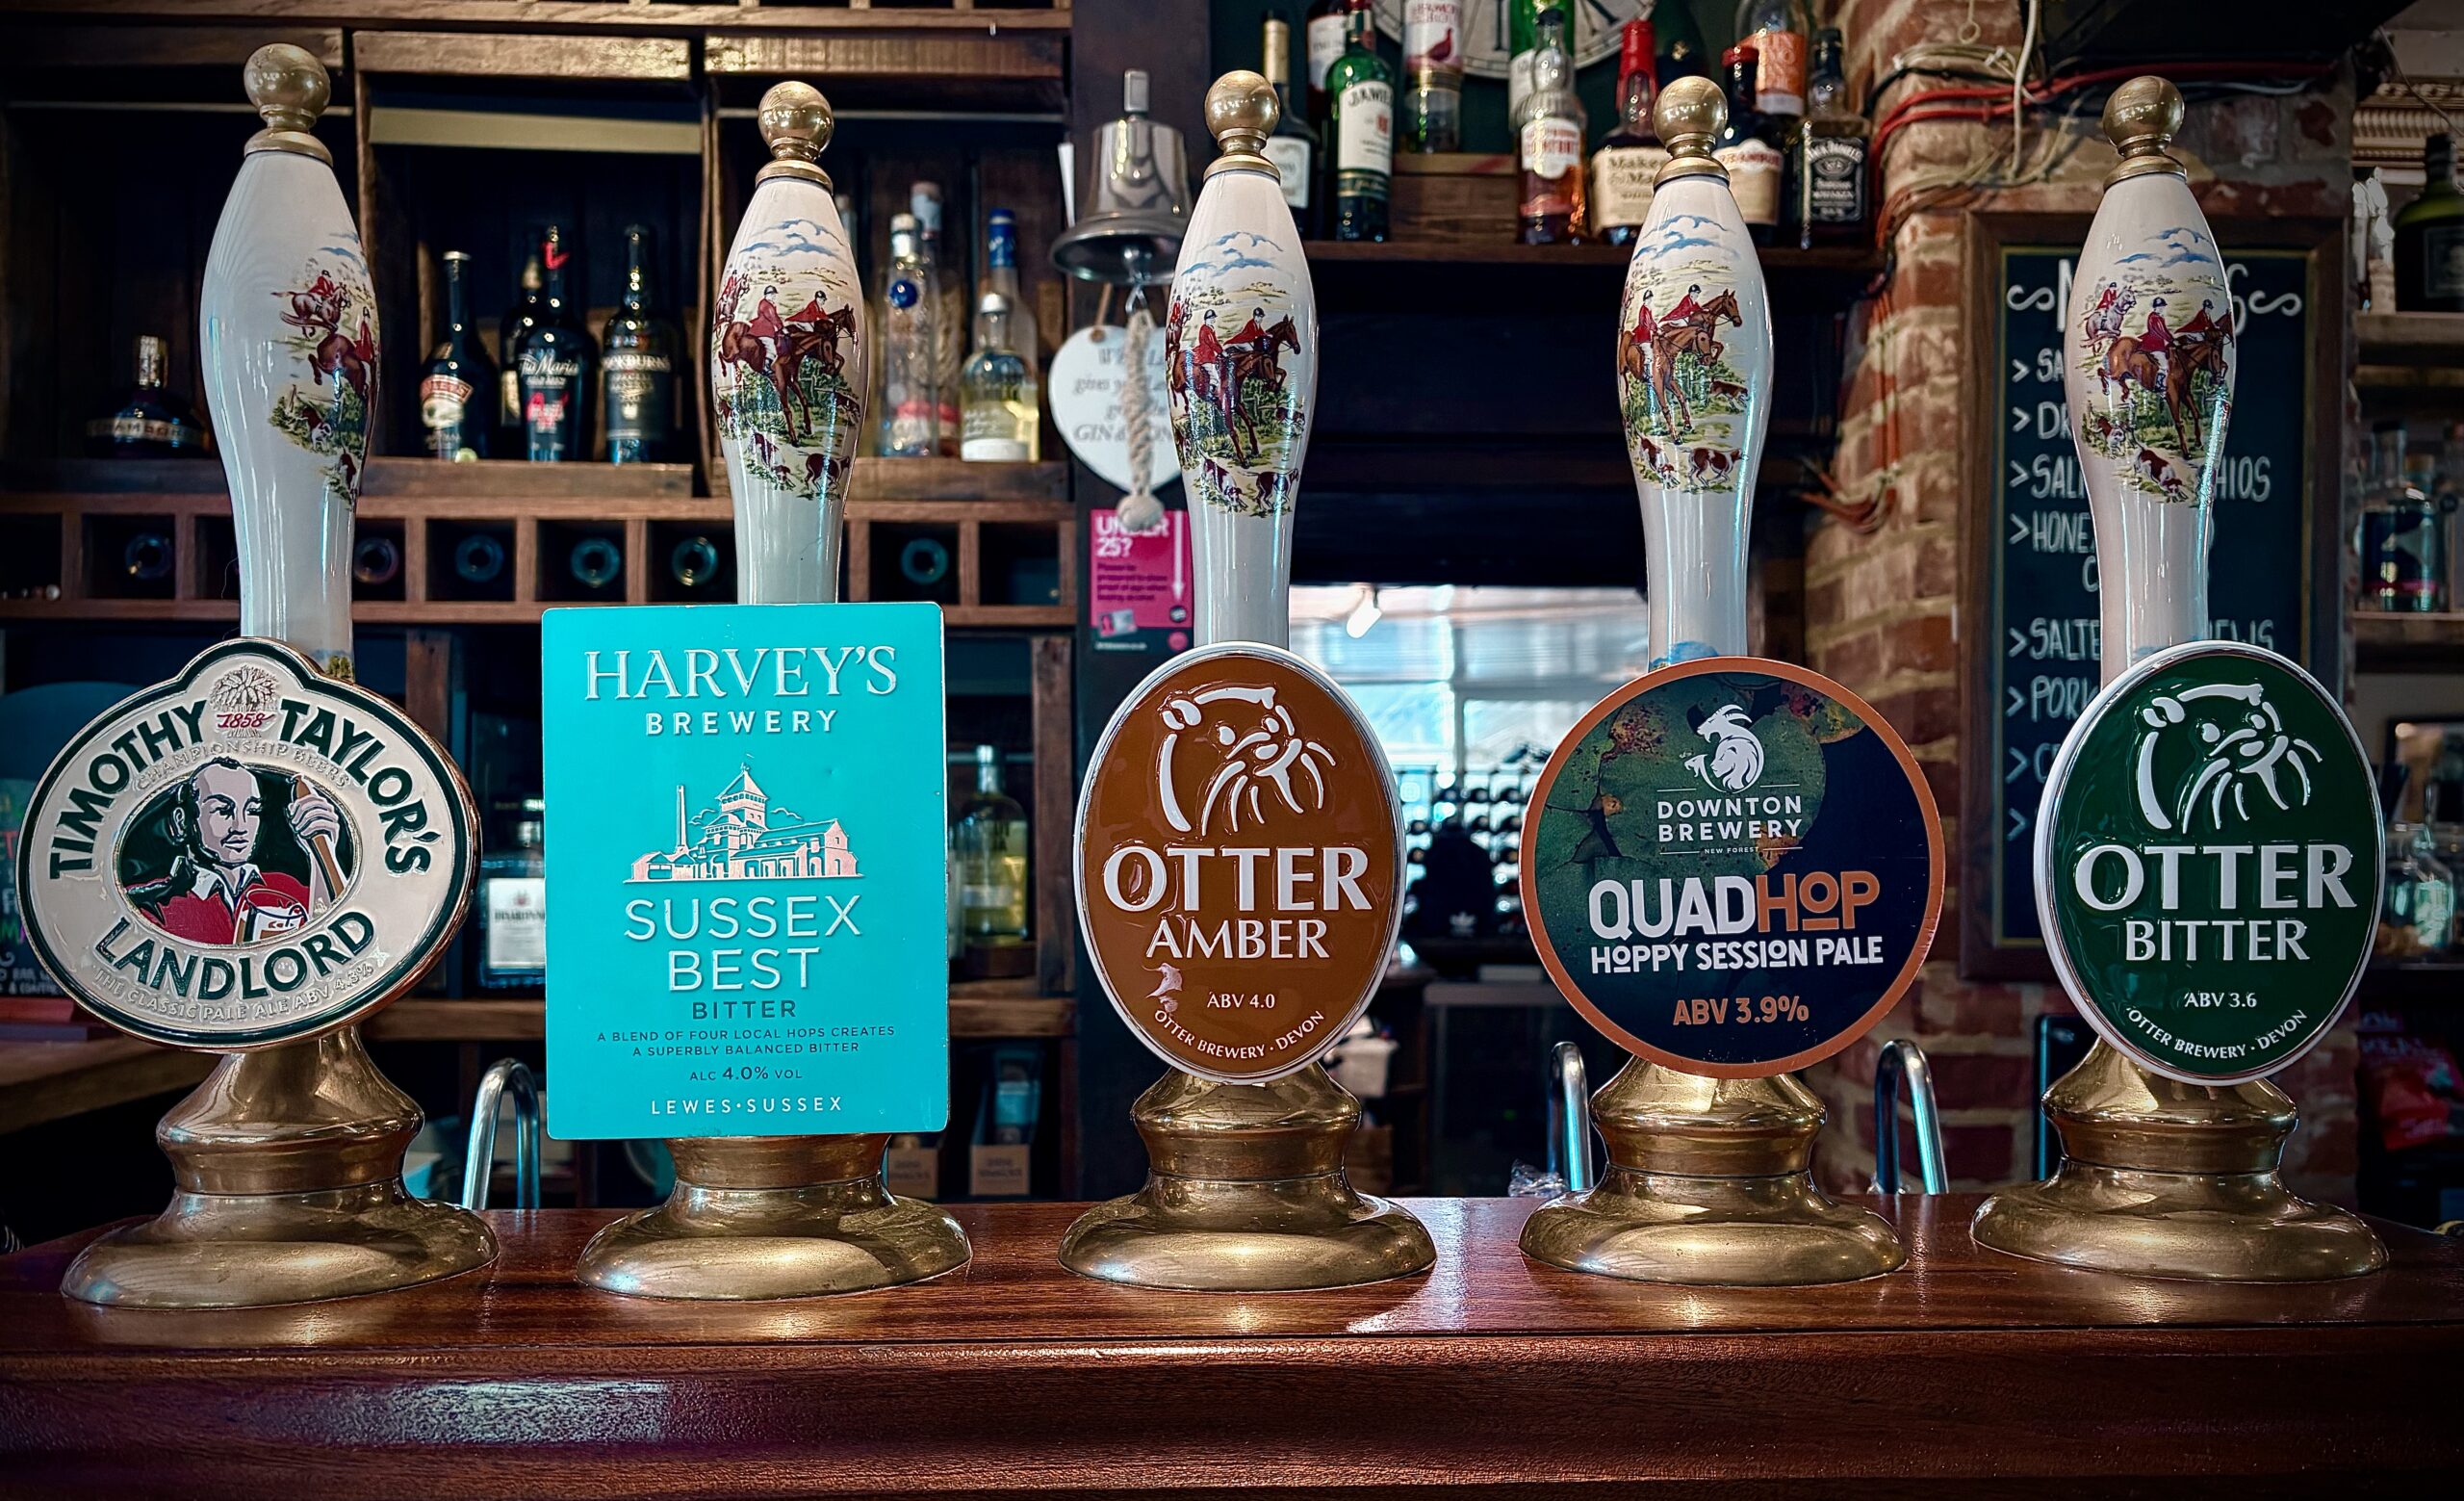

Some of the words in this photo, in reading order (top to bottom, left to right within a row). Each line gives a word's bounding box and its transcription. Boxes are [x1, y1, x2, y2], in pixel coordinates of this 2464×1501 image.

[1097, 536, 1133, 557] 25?
[2032, 511, 2095, 554] HONE
[2029, 618, 2100, 660] SALTE
[584, 645, 897, 701] HARVEY'S
[216, 712, 274, 731] 1858
[645, 710, 838, 736] BREWERY
[137, 740, 288, 789] CHAMPIONSHIP
[293, 749, 350, 788] BEERS
[50, 699, 207, 880] TIMOTHY
[279, 697, 442, 877] TAYLOR'S
[1656, 795, 1802, 820] DOWNTON
[1658, 818, 1803, 842] BREWERY
[1727, 845, 1759, 854] FOREST
[1102, 845, 1373, 913] OTTER
[2074, 843, 2357, 912] OTTER
[624, 893, 861, 941] SUSSEX
[95, 910, 374, 1000] LANDLORD
[1146, 918, 1330, 959] AMBER
[1590, 944, 1689, 974] HOPPY
[1697, 939, 1809, 971] SESSION
[1816, 936, 1884, 967] PALE
[2125, 919, 2310, 962] BITTER
[669, 946, 822, 993] BEST
[95, 970, 123, 995] THE
[126, 989, 197, 1018] CLASSIC
[203, 1005, 246, 1021] PALE
[254, 1001, 289, 1018] ALE
[294, 986, 331, 1010] ABV
[335, 963, 374, 991] 4.3%
[692, 999, 797, 1021] BITTER
[1207, 993, 1245, 1009] ABV
[1249, 993, 1275, 1009] 4.0
[1673, 998, 1729, 1025] ABV
[1735, 996, 1810, 1024] 3.9%
[2185, 992, 2225, 1008] ABV
[2228, 992, 2257, 1008] 3.6
[597, 1032, 607, 1042] A
[611, 1030, 659, 1042] BLEND
[664, 1030, 684, 1041] OF
[689, 1029, 729, 1040] FOUR
[733, 1028, 782, 1040] LOCAL
[786, 1027, 826, 1039] HOPS
[831, 1025, 895, 1038] CREATES
[632, 1047, 642, 1057] A
[646, 1045, 719, 1056] SUPERBLY
[725, 1044, 804, 1055] BALANCED
[809, 1042, 860, 1053] BITTER
[1154, 1009, 1194, 1048] OTTER
[1197, 1039, 1266, 1059] BREWERY
[1275, 1009, 1325, 1050] DEVON
[2126, 1008, 2170, 1046] OTTER
[2174, 1038, 2246, 1059] BREWERY
[2258, 1009, 2308, 1050] DEVON
[689, 1070, 717, 1081] ALC
[722, 1066, 769, 1082] 4.0%
[774, 1069, 803, 1079] VOL
